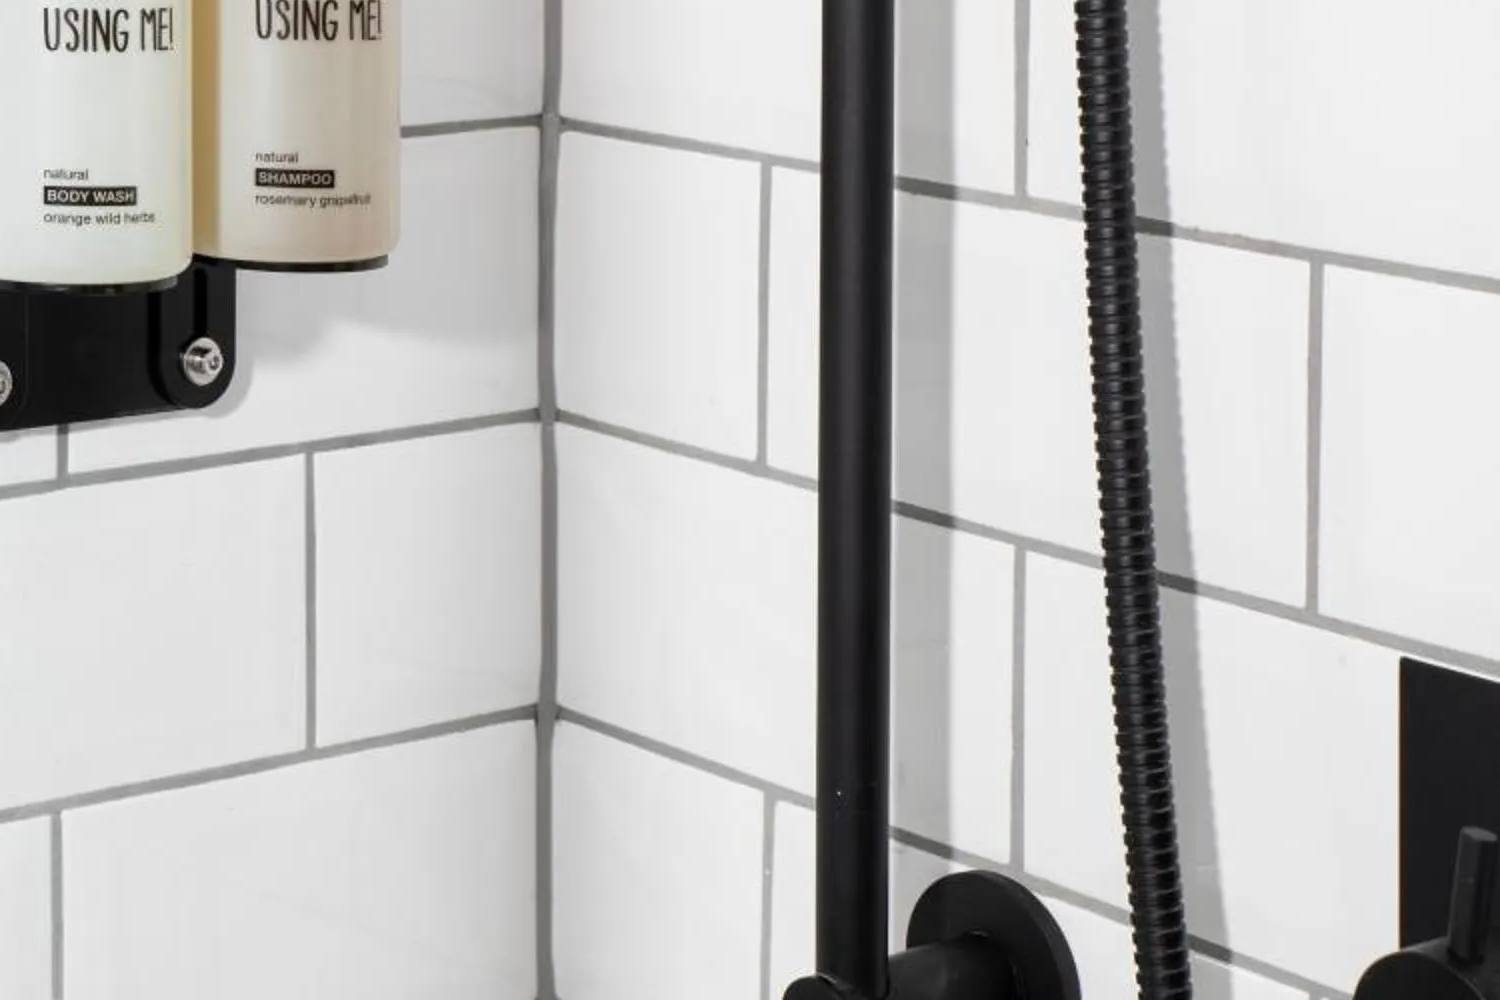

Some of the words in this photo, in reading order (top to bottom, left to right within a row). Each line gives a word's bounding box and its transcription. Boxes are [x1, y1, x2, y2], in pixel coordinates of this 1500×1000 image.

[43, 7, 130, 54] USING
[140, 7, 175, 52] ME!
[255, 151, 299, 164] natural
[43, 168, 89, 181] natural
[258, 170, 332, 186] SHAMPOO
[46, 188, 90, 203] BODY
[93, 189, 135, 204] WASH
[255, 194, 317, 208] rosemary
[43, 212, 92, 228] orange
[95, 211, 121, 225] wild
